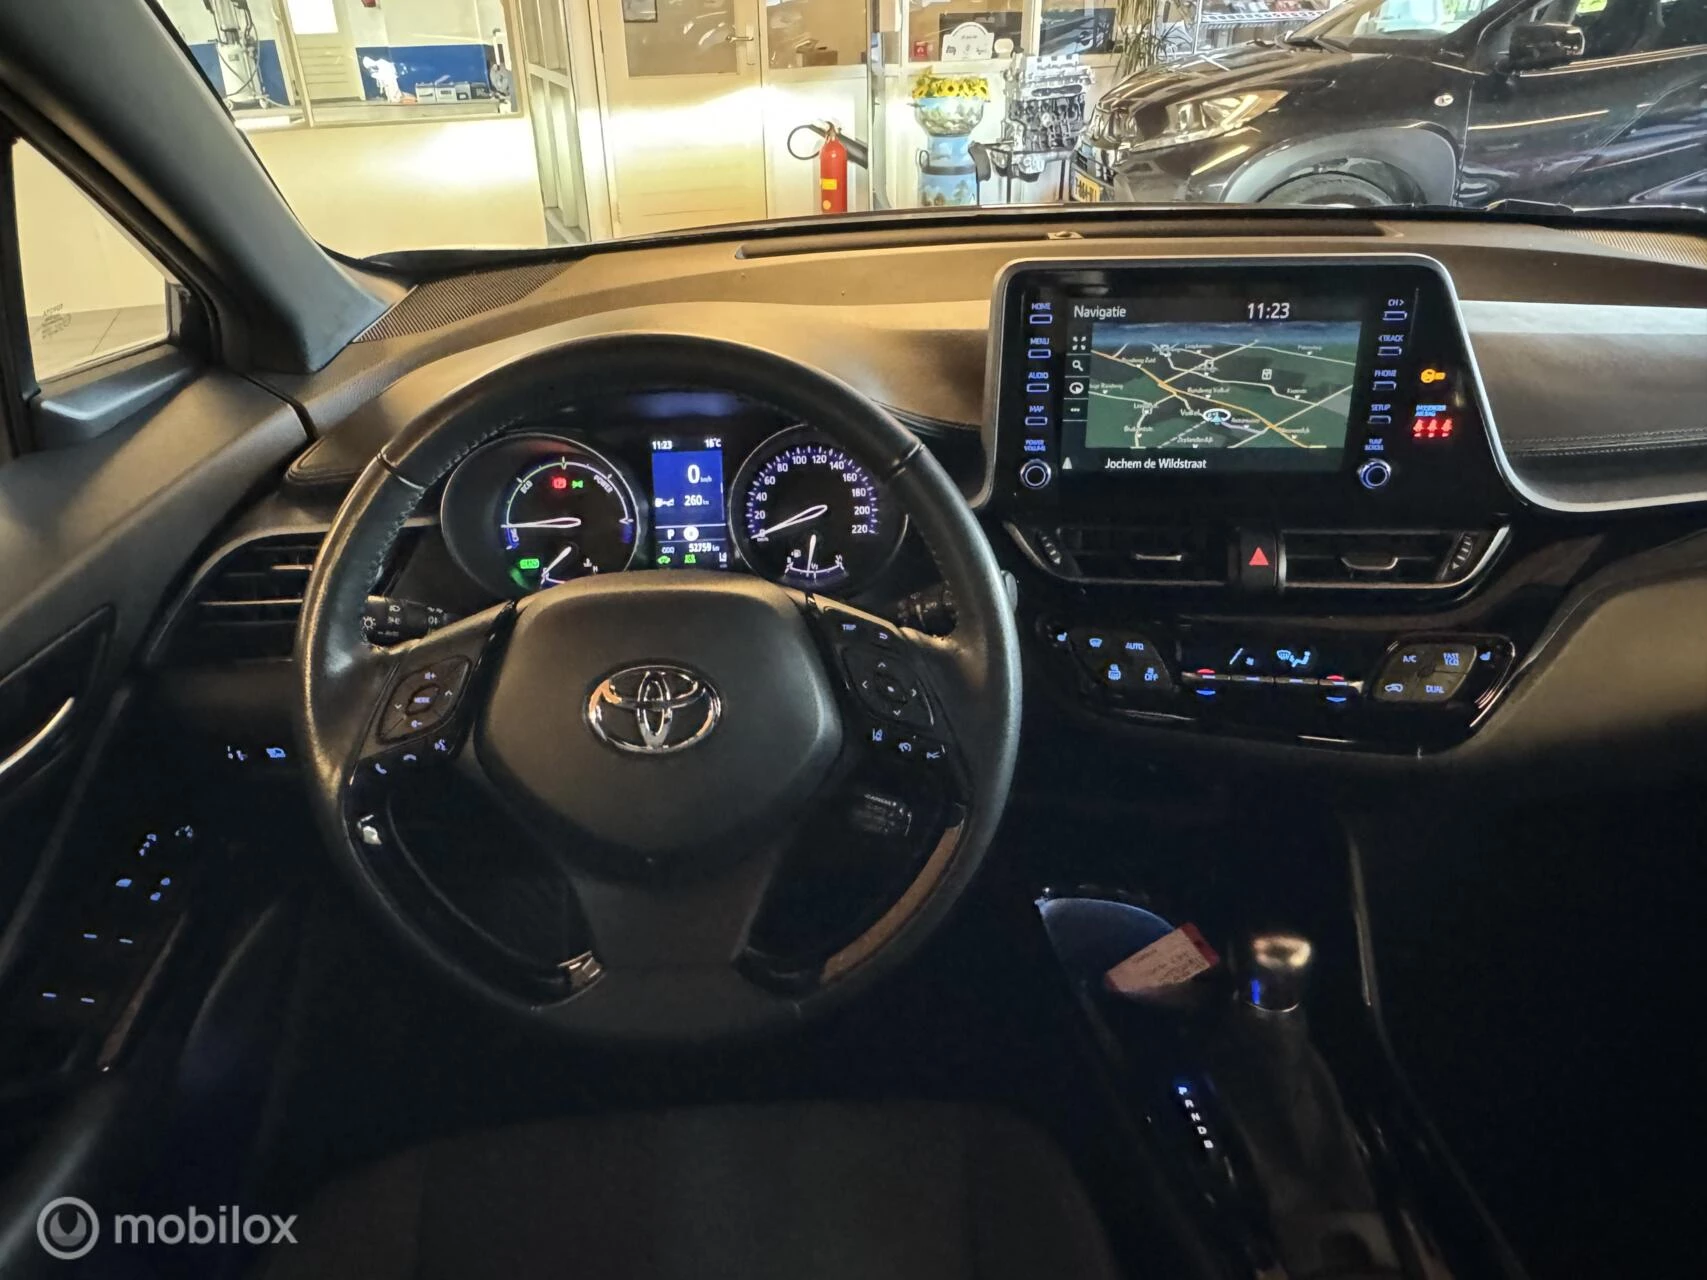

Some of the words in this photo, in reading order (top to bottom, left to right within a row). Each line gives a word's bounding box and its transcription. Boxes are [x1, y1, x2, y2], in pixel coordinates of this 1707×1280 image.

[1032, 303, 1050, 311] HOME
[1247, 302, 1290, 319] 11:23
[1074, 304, 1126, 320] Navigatie
[1028, 371, 1049, 379] AUDIO
[1374, 370, 1397, 378] PHONE
[1371, 404, 1391, 412] SETUP
[652, 440, 673, 450] 11:23
[791, 455, 807, 465] 100
[812, 454, 827, 464] 120
[1105, 458, 1141, 469] Jochem
[1144, 458, 1156, 469] de
[1159, 458, 1207, 469] Wildstraat
[777, 463, 788, 472] 80
[830, 460, 844, 470] 140
[687, 464, 700, 484] 0
[843, 473, 857, 482] 160
[764, 475, 776, 485] 60
[756, 492, 767, 501] 40
[852, 488, 866, 497] 180
[684, 495, 702, 506] 260
[755, 510, 765, 519] 20
[854, 506, 870, 515] 200
[852, 524, 868, 534] 220
[842, 623, 856, 631] TRIP
[1125, 642, 1144, 650] AUTO
[1403, 655, 1417, 663] A/C
[1144, 672, 1159, 681] OFF
[1425, 685, 1445, 694] DUAL
[1185, 1099, 1194, 1108] R
[1191, 1112, 1201, 1122] N
[1197, 1126, 1207, 1135] D
[1204, 1140, 1214, 1149] B
